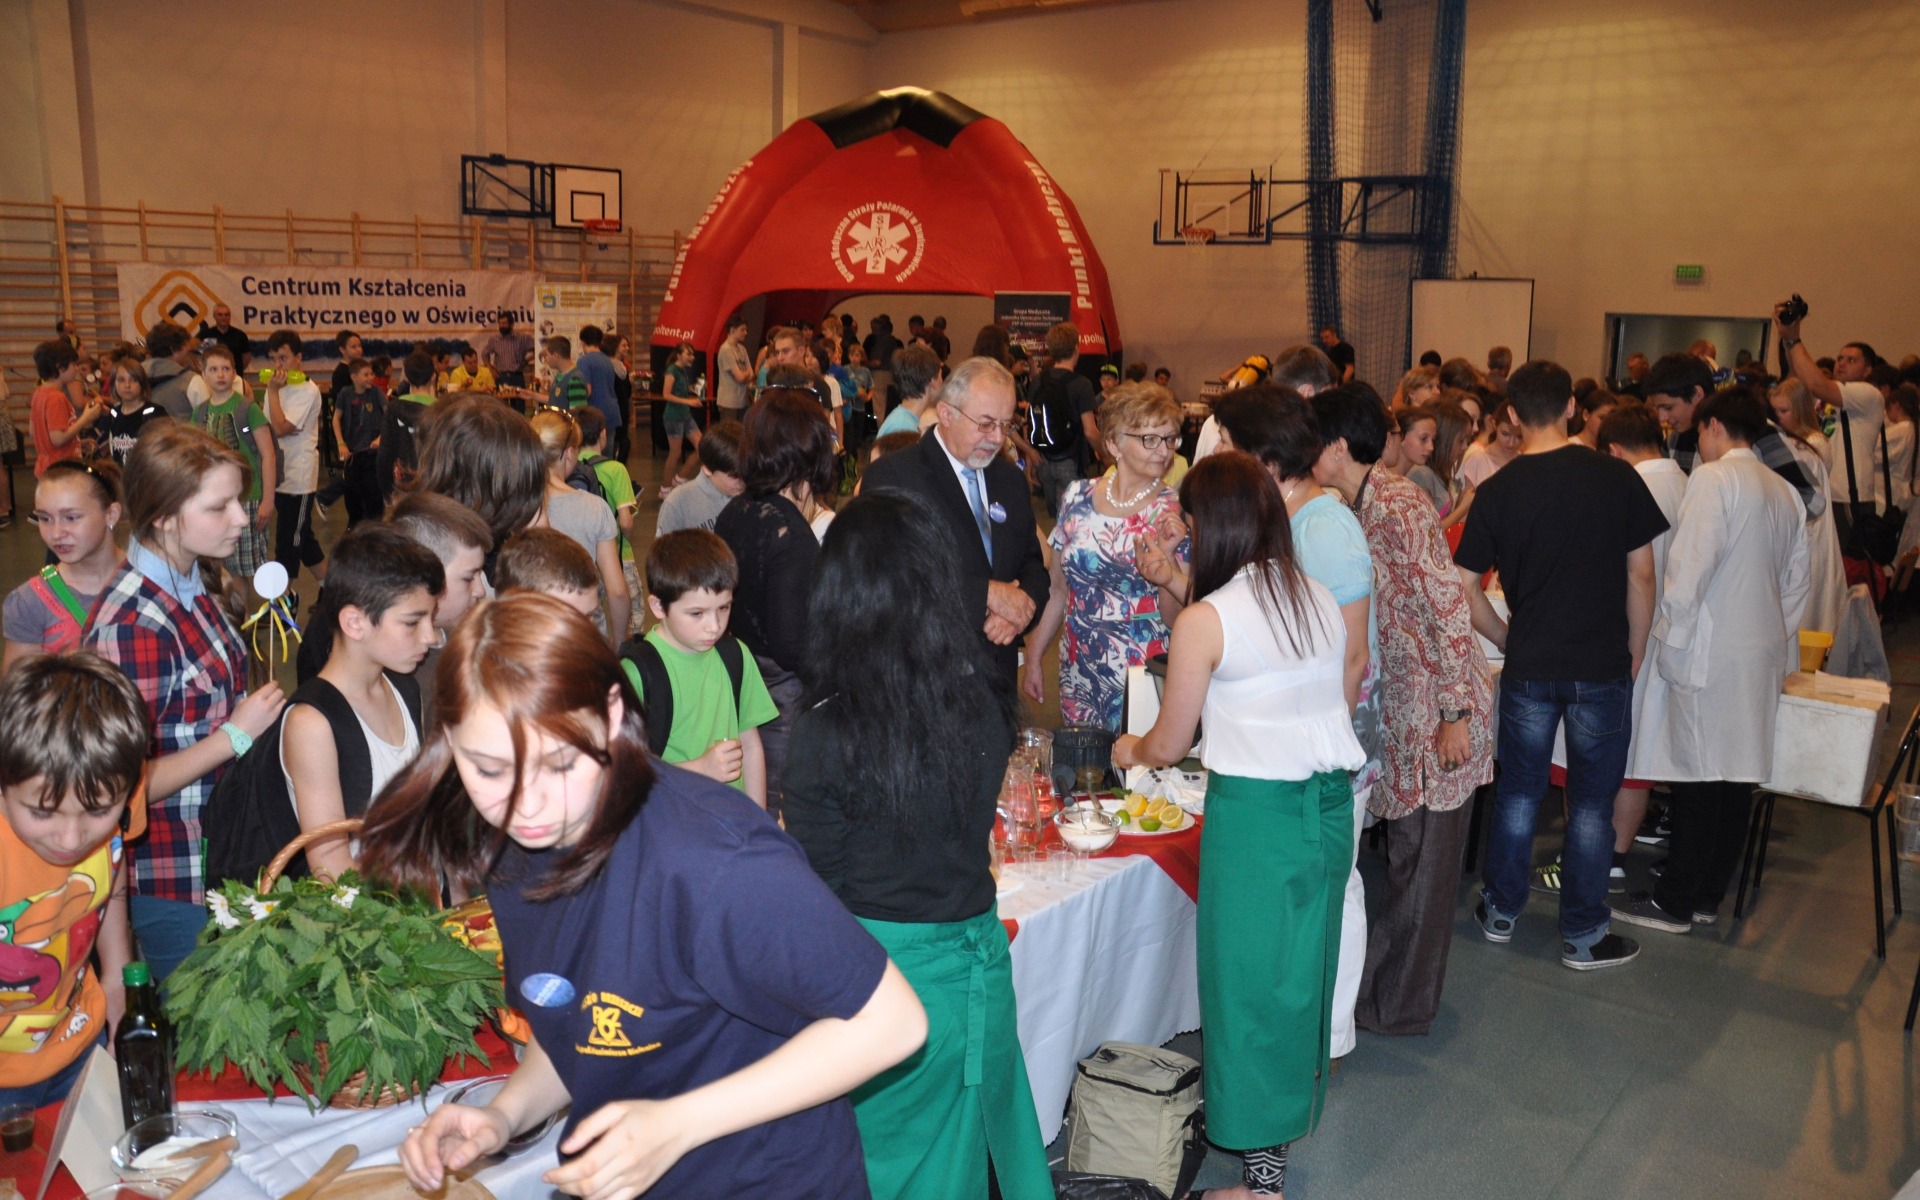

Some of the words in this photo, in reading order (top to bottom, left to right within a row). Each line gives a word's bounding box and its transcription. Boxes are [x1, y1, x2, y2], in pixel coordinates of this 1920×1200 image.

[241, 275, 341, 296] Centrum
[348, 277, 466, 297] Kształcenia
[1067, 247, 1093, 310] Punkt
[243, 305, 397, 329] Praktycznego
[402, 310, 420, 324] w
